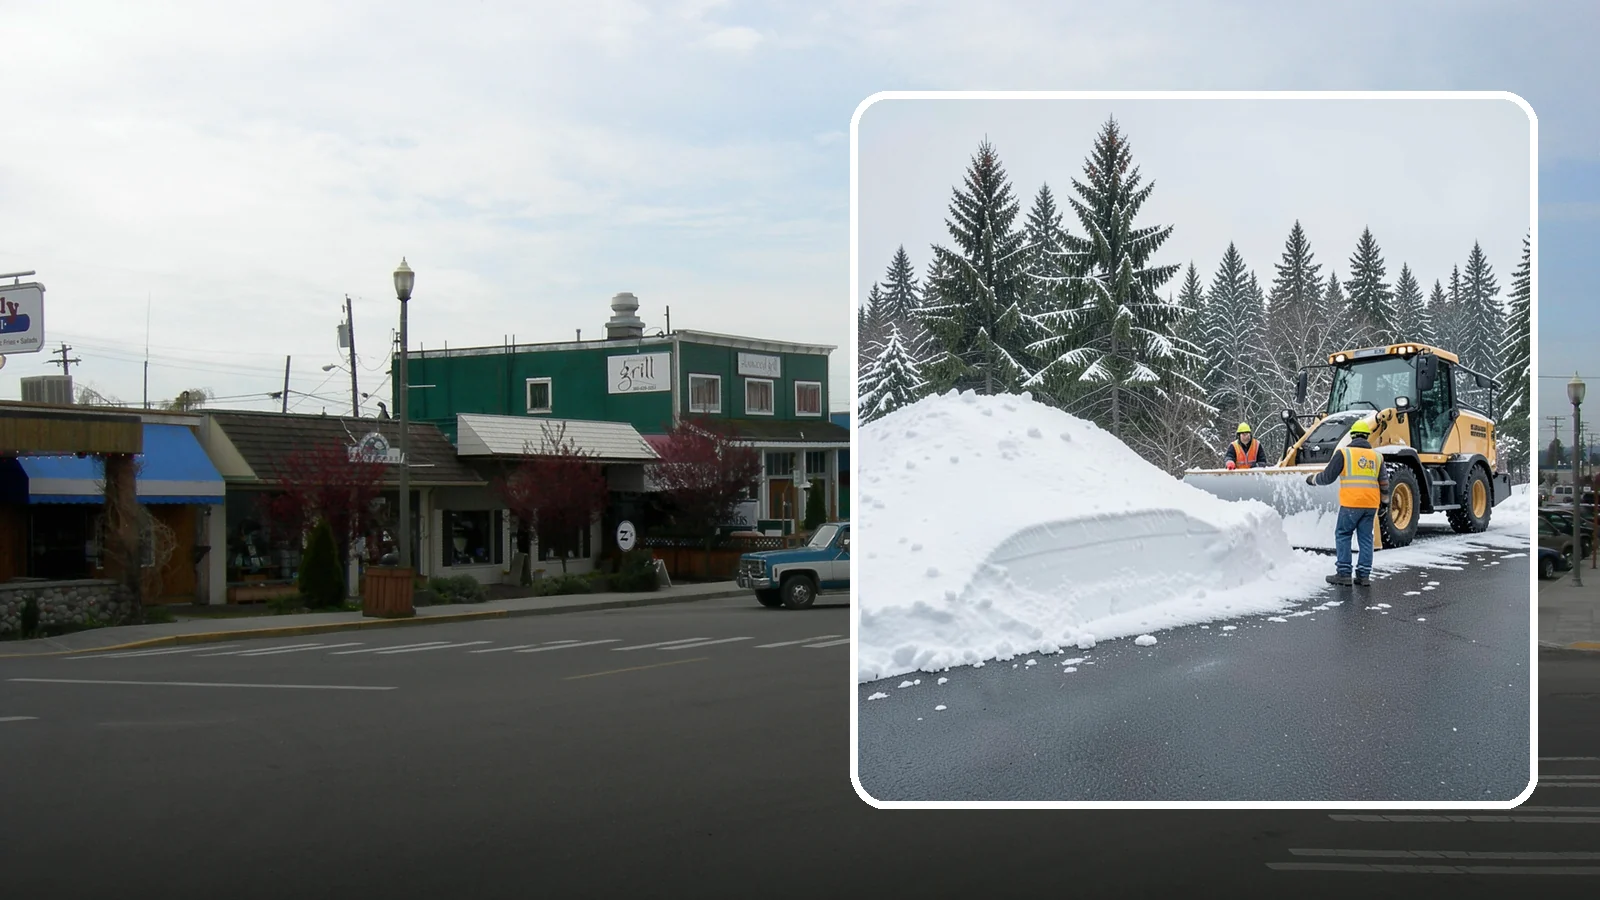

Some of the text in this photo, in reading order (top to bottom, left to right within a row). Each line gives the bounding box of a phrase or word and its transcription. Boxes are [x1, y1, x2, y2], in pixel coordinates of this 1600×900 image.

[3, 337, 38, 346] Fries Salads
[618, 356, 654, 391] grill
